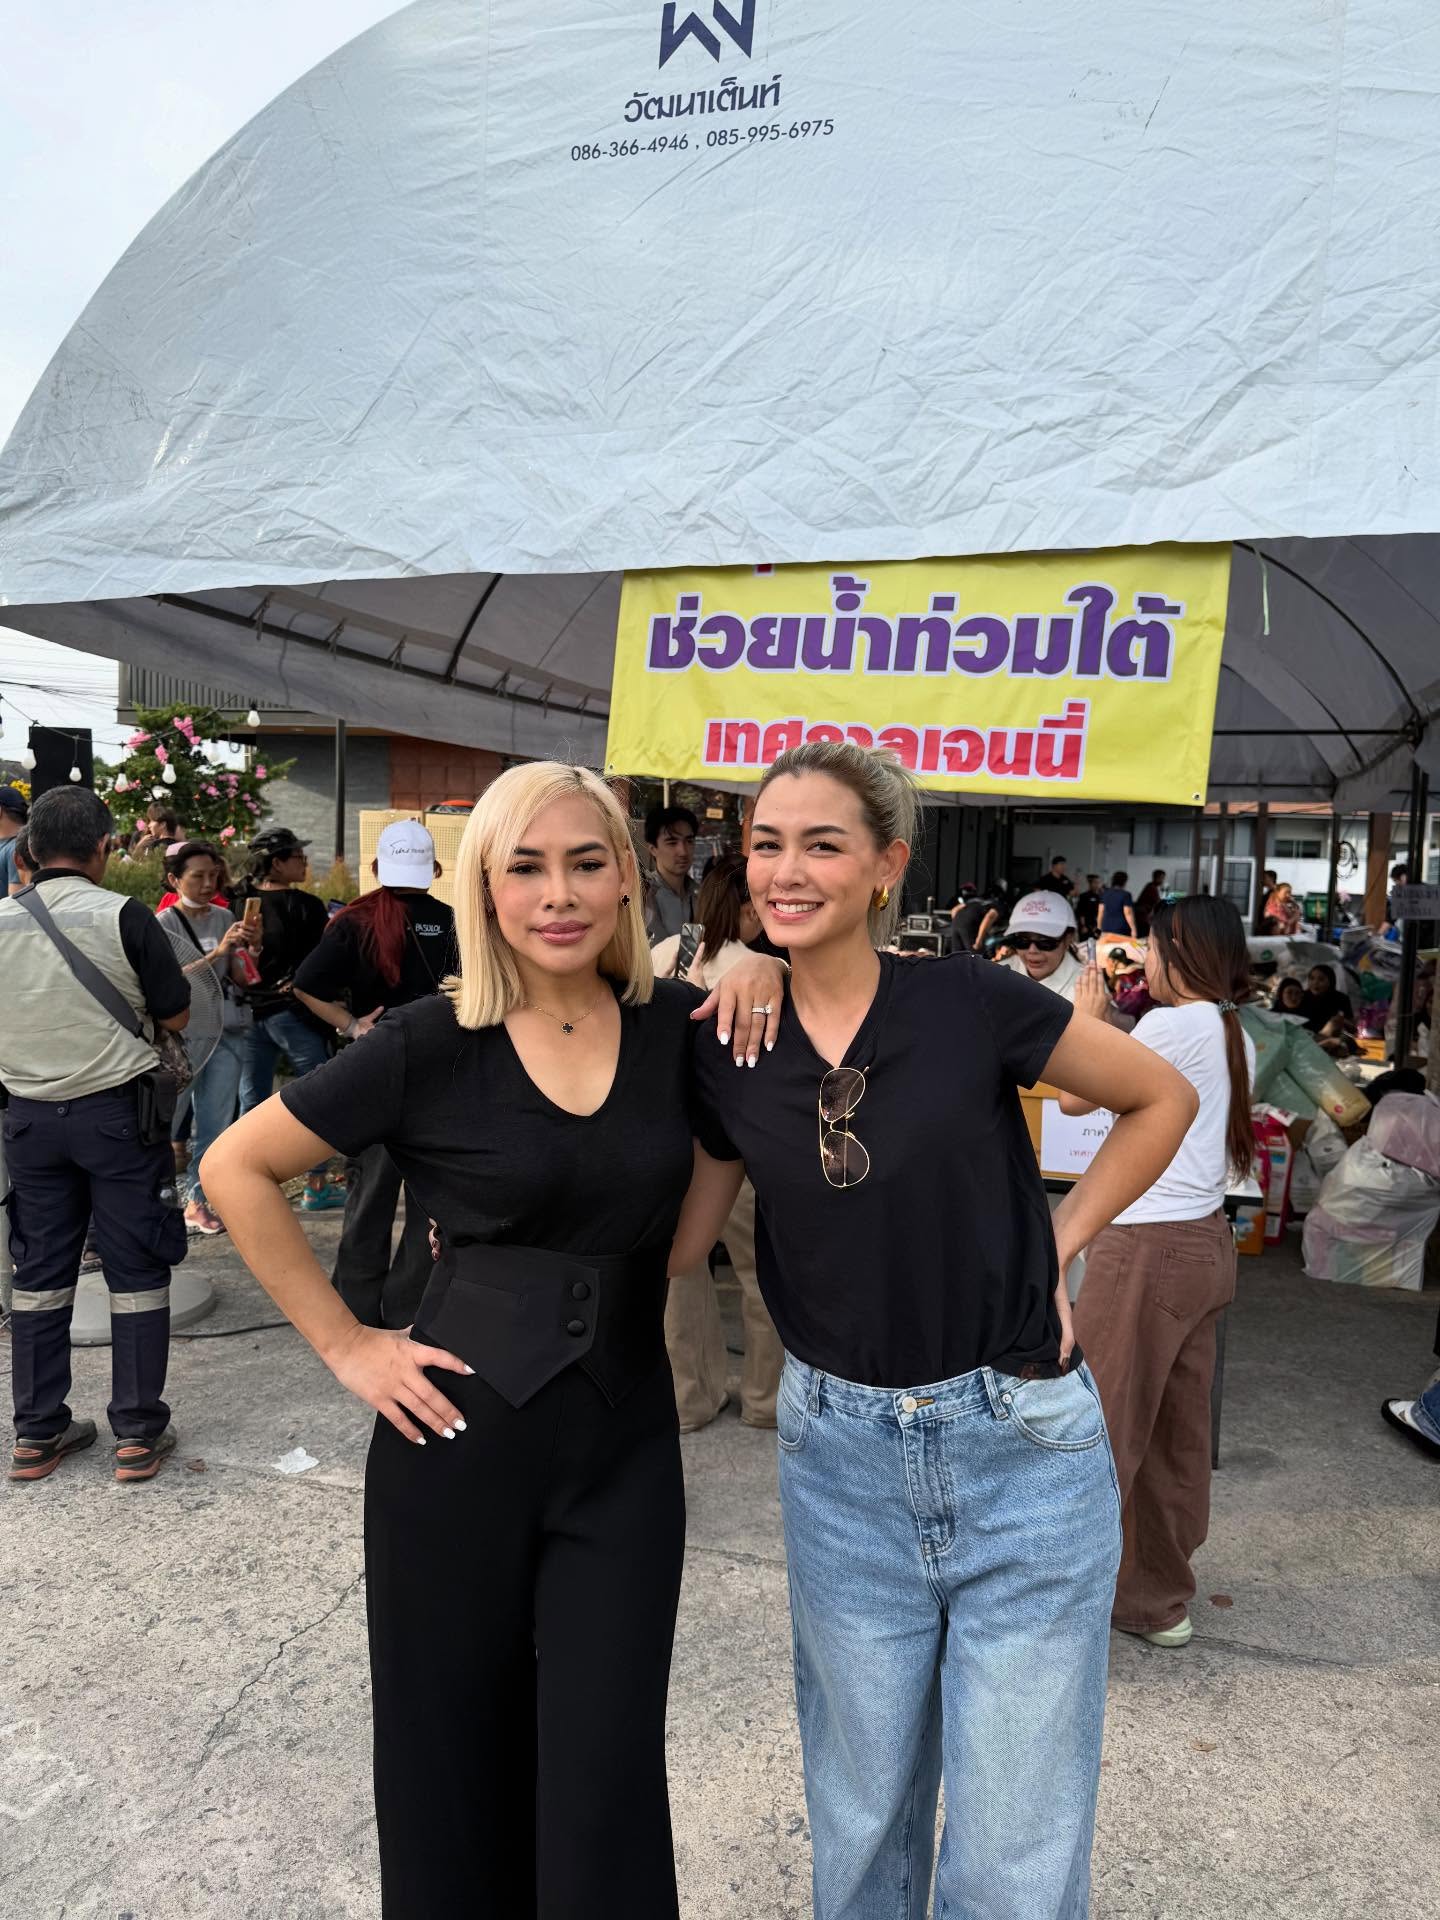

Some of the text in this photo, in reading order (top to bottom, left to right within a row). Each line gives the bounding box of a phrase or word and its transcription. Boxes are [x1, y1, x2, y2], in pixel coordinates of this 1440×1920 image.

[624, 74, 782, 122] วัฒนาเต็นท์
[571, 133, 688, 161] 086-366-4946
[706, 119, 834, 147] 085-995-6975
[648, 576, 1183, 678] ช่วยน้ำท่วมใต้
[1082, 1125, 1109, 1137] ภาคใ
